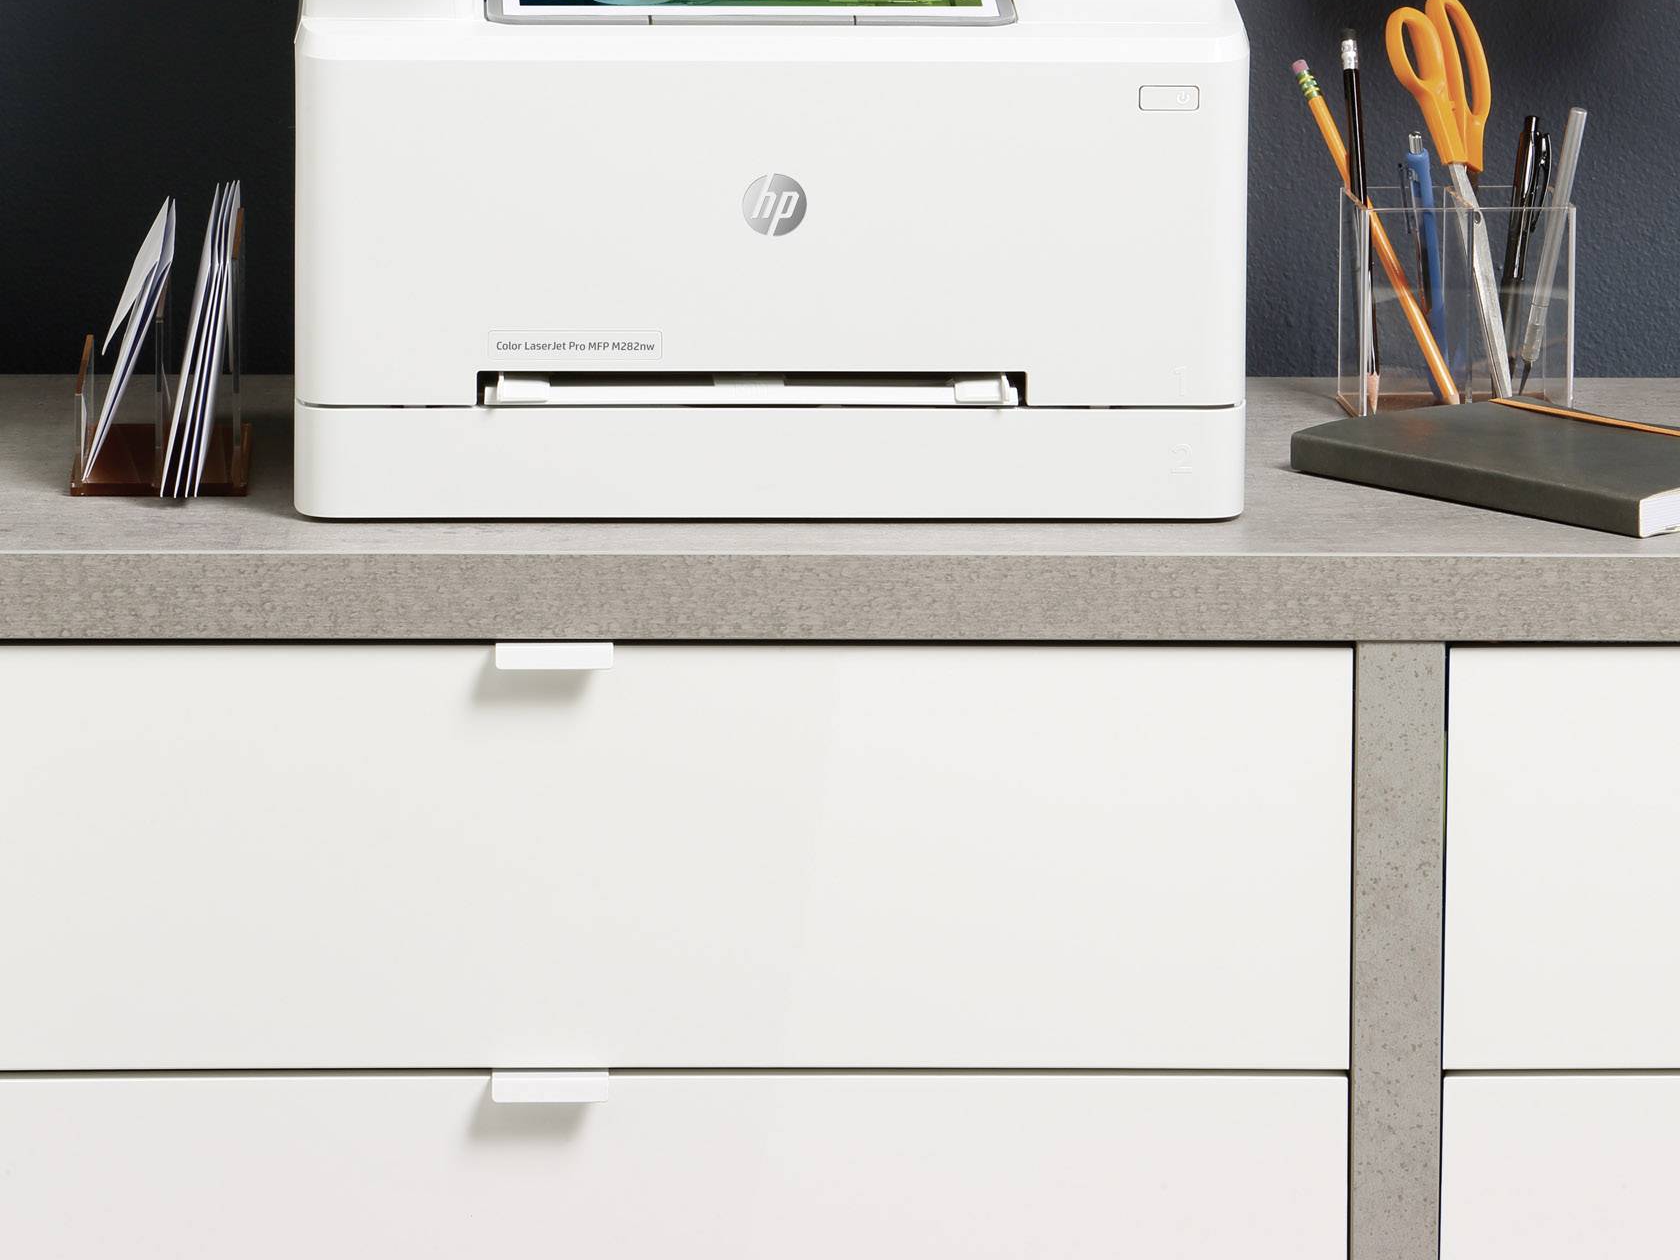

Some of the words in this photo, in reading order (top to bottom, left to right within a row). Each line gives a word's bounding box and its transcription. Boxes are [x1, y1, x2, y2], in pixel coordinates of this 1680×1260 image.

[751, 173, 800, 236] hp
[496, 342, 522, 351] Color
[524, 342, 566, 351] LaserJet
[568, 342, 586, 351] Pro
[588, 342, 610, 351] MFP
[611, 342, 655, 351] M282nw
